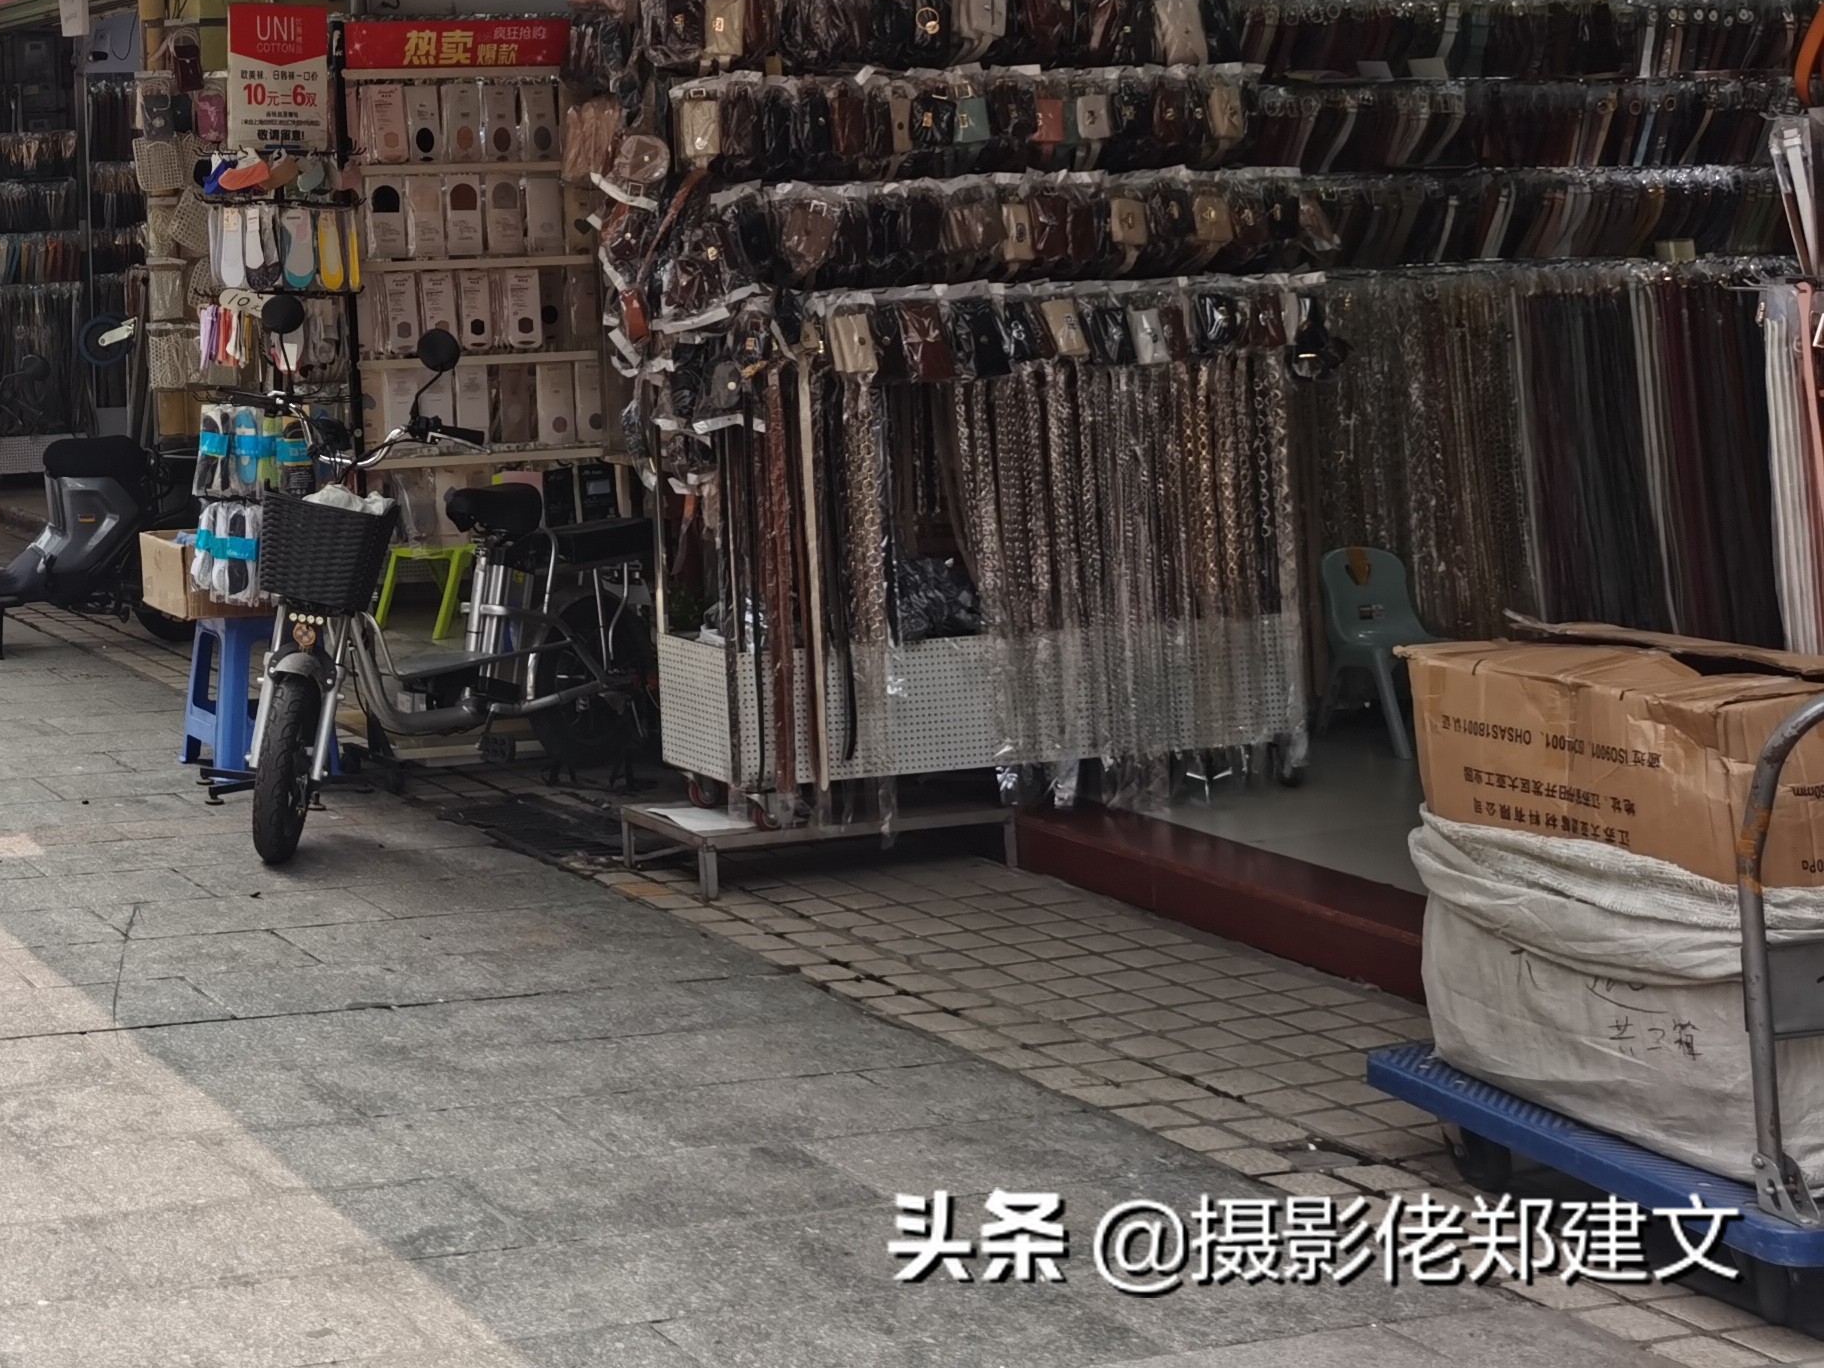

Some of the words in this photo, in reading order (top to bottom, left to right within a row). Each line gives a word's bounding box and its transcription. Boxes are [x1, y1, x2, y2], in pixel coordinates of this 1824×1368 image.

[256, 15, 294, 41] UNI
[256, 43, 295, 54] COTTON
[403, 30, 474, 65] 热卖
[476, 43, 519, 65] 爆款
